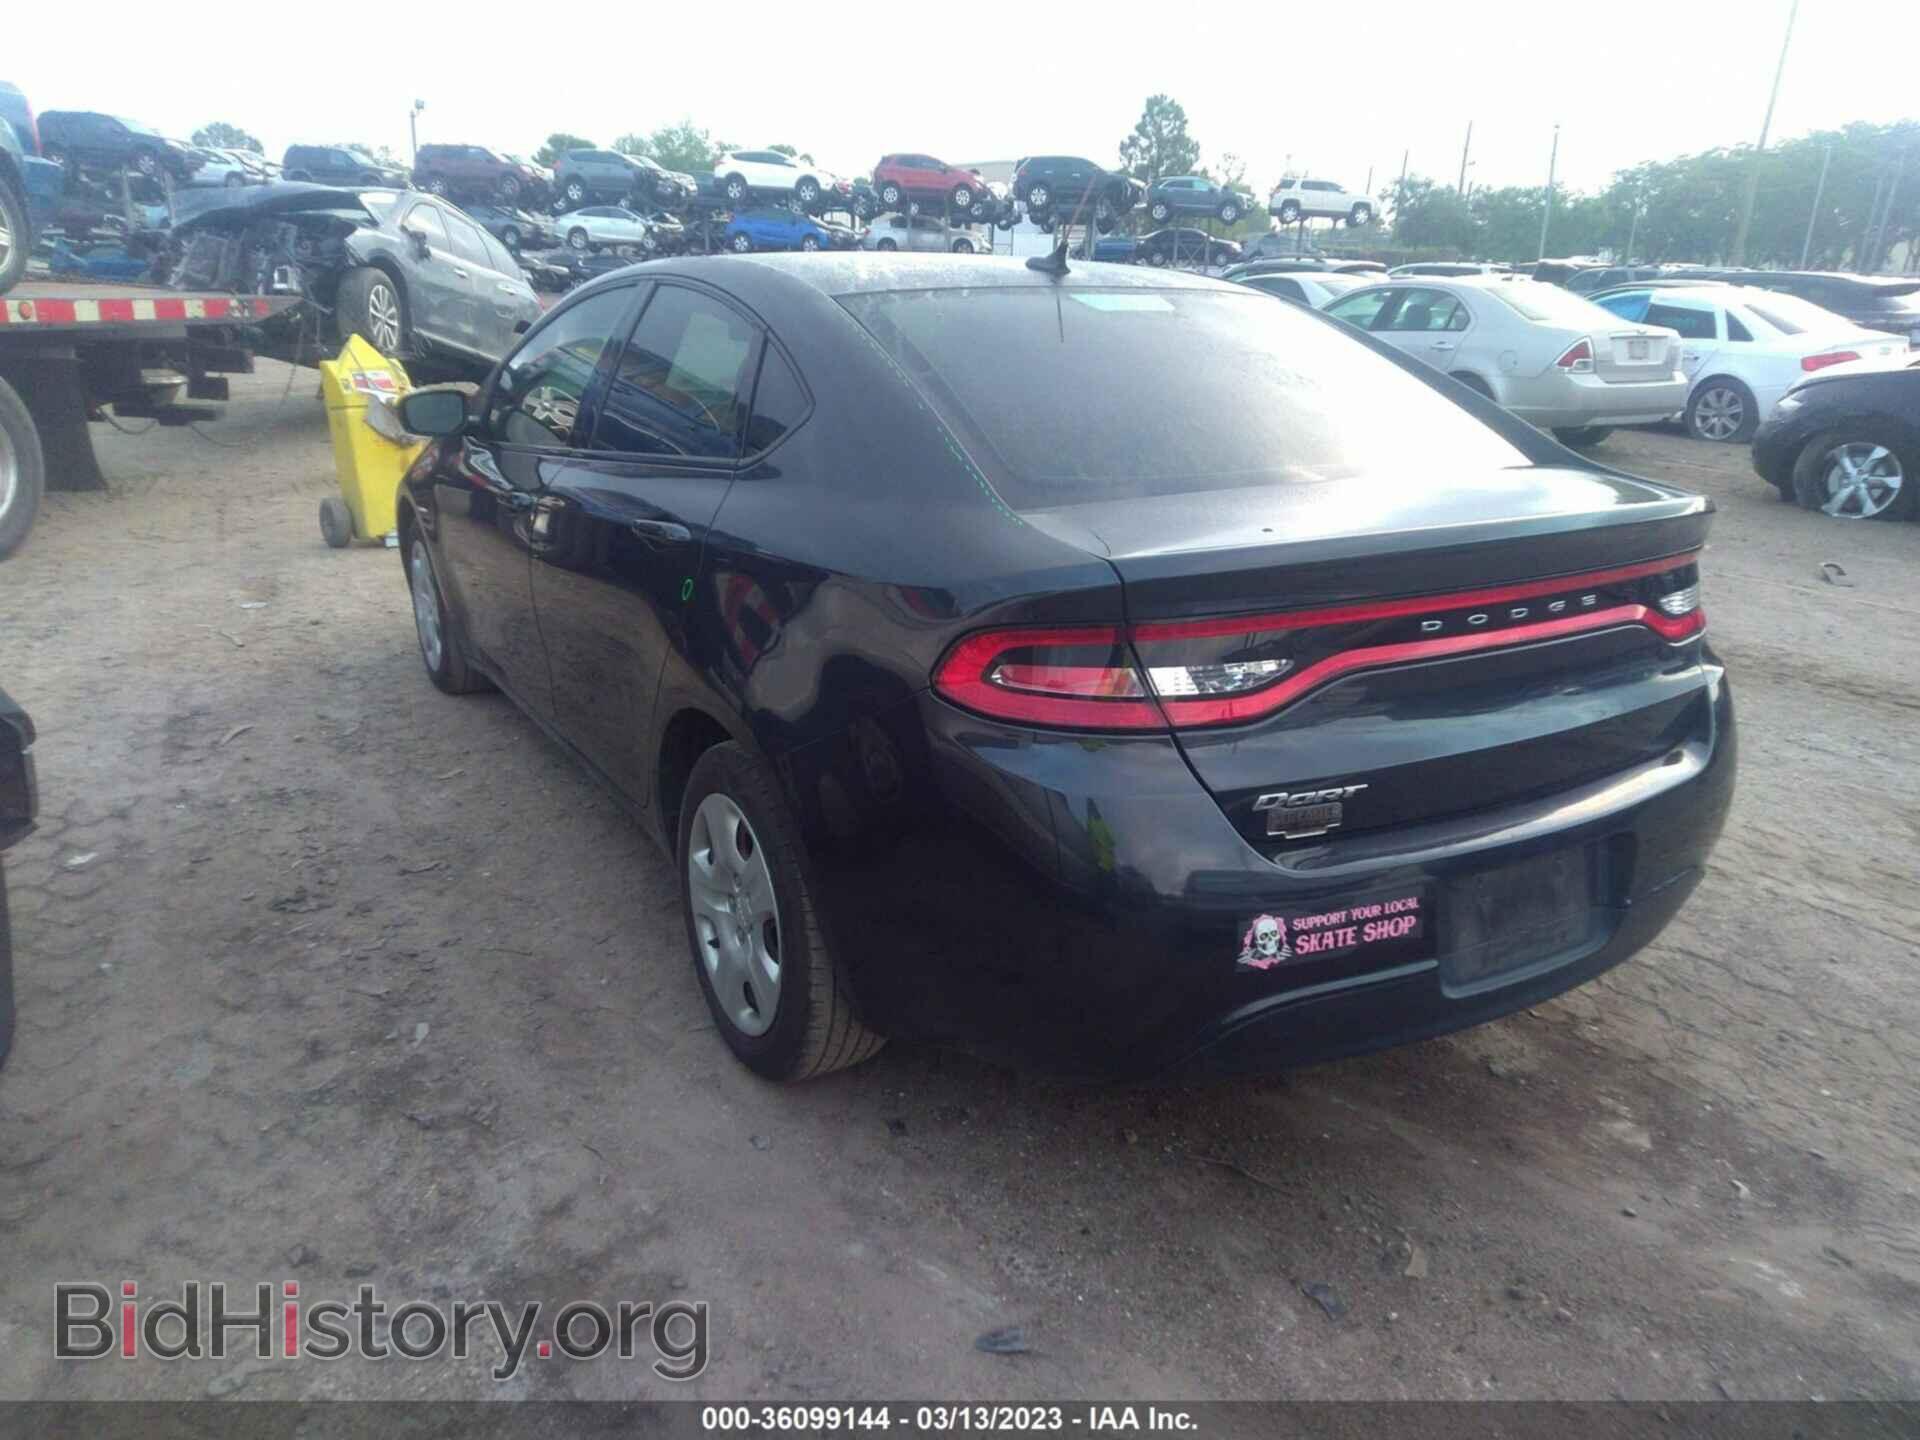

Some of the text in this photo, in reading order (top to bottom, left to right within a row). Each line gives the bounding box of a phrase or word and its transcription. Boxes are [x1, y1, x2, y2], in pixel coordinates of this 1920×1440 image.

[1421, 594, 1597, 632] DODGE
[1293, 897, 1420, 931] SUPPORT YOUR LOCAL
[1295, 915, 1417, 955] SKATE SHOP
